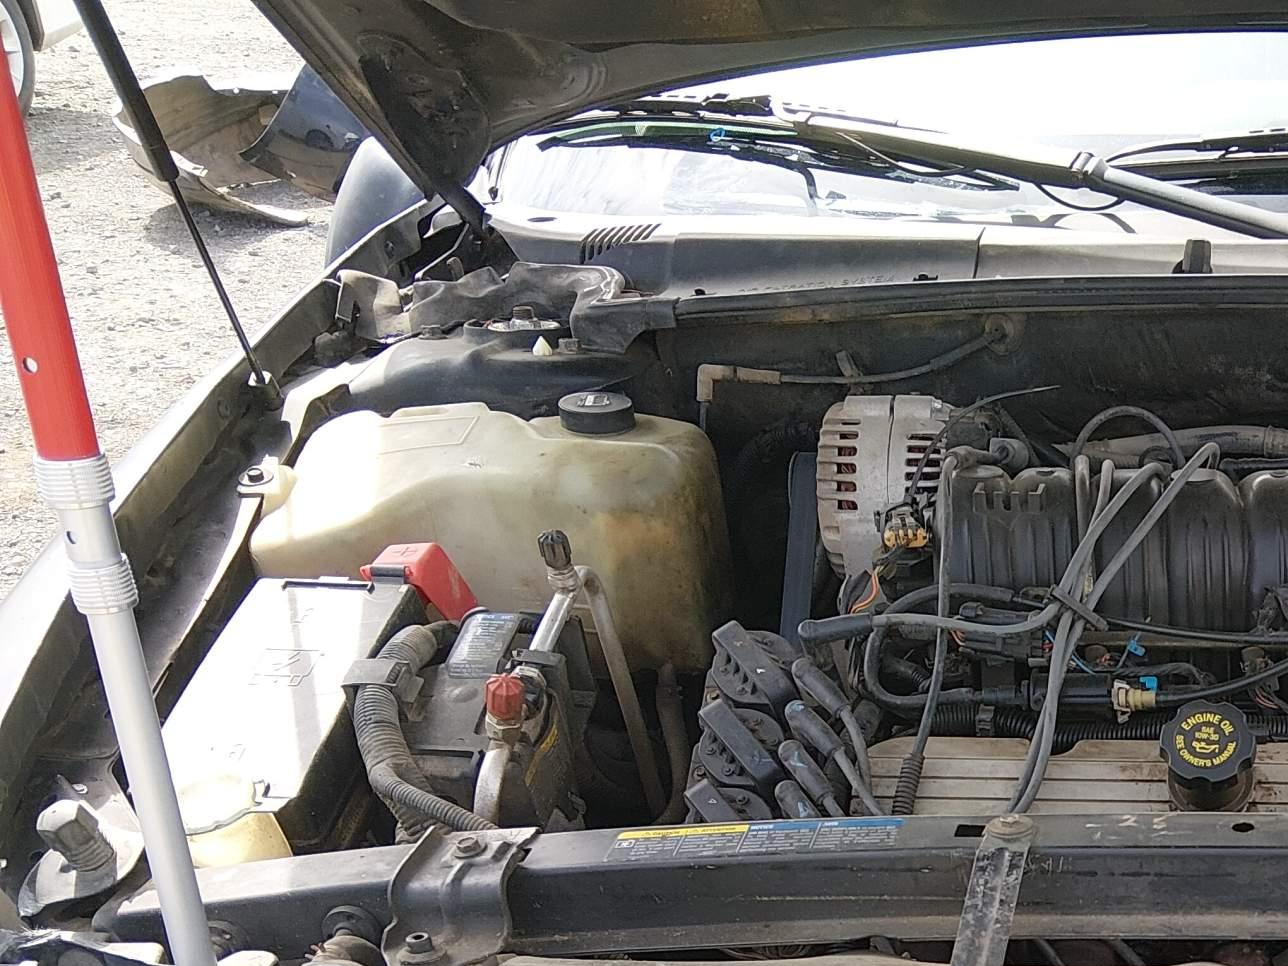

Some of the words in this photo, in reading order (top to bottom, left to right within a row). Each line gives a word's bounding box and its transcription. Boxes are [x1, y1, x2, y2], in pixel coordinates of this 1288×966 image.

[1181, 713, 1222, 730] ENGINE
[1220, 720, 1234, 736] OIL
[1176, 734, 1185, 750] SEE
[1212, 741, 1237, 766] MANUAL
